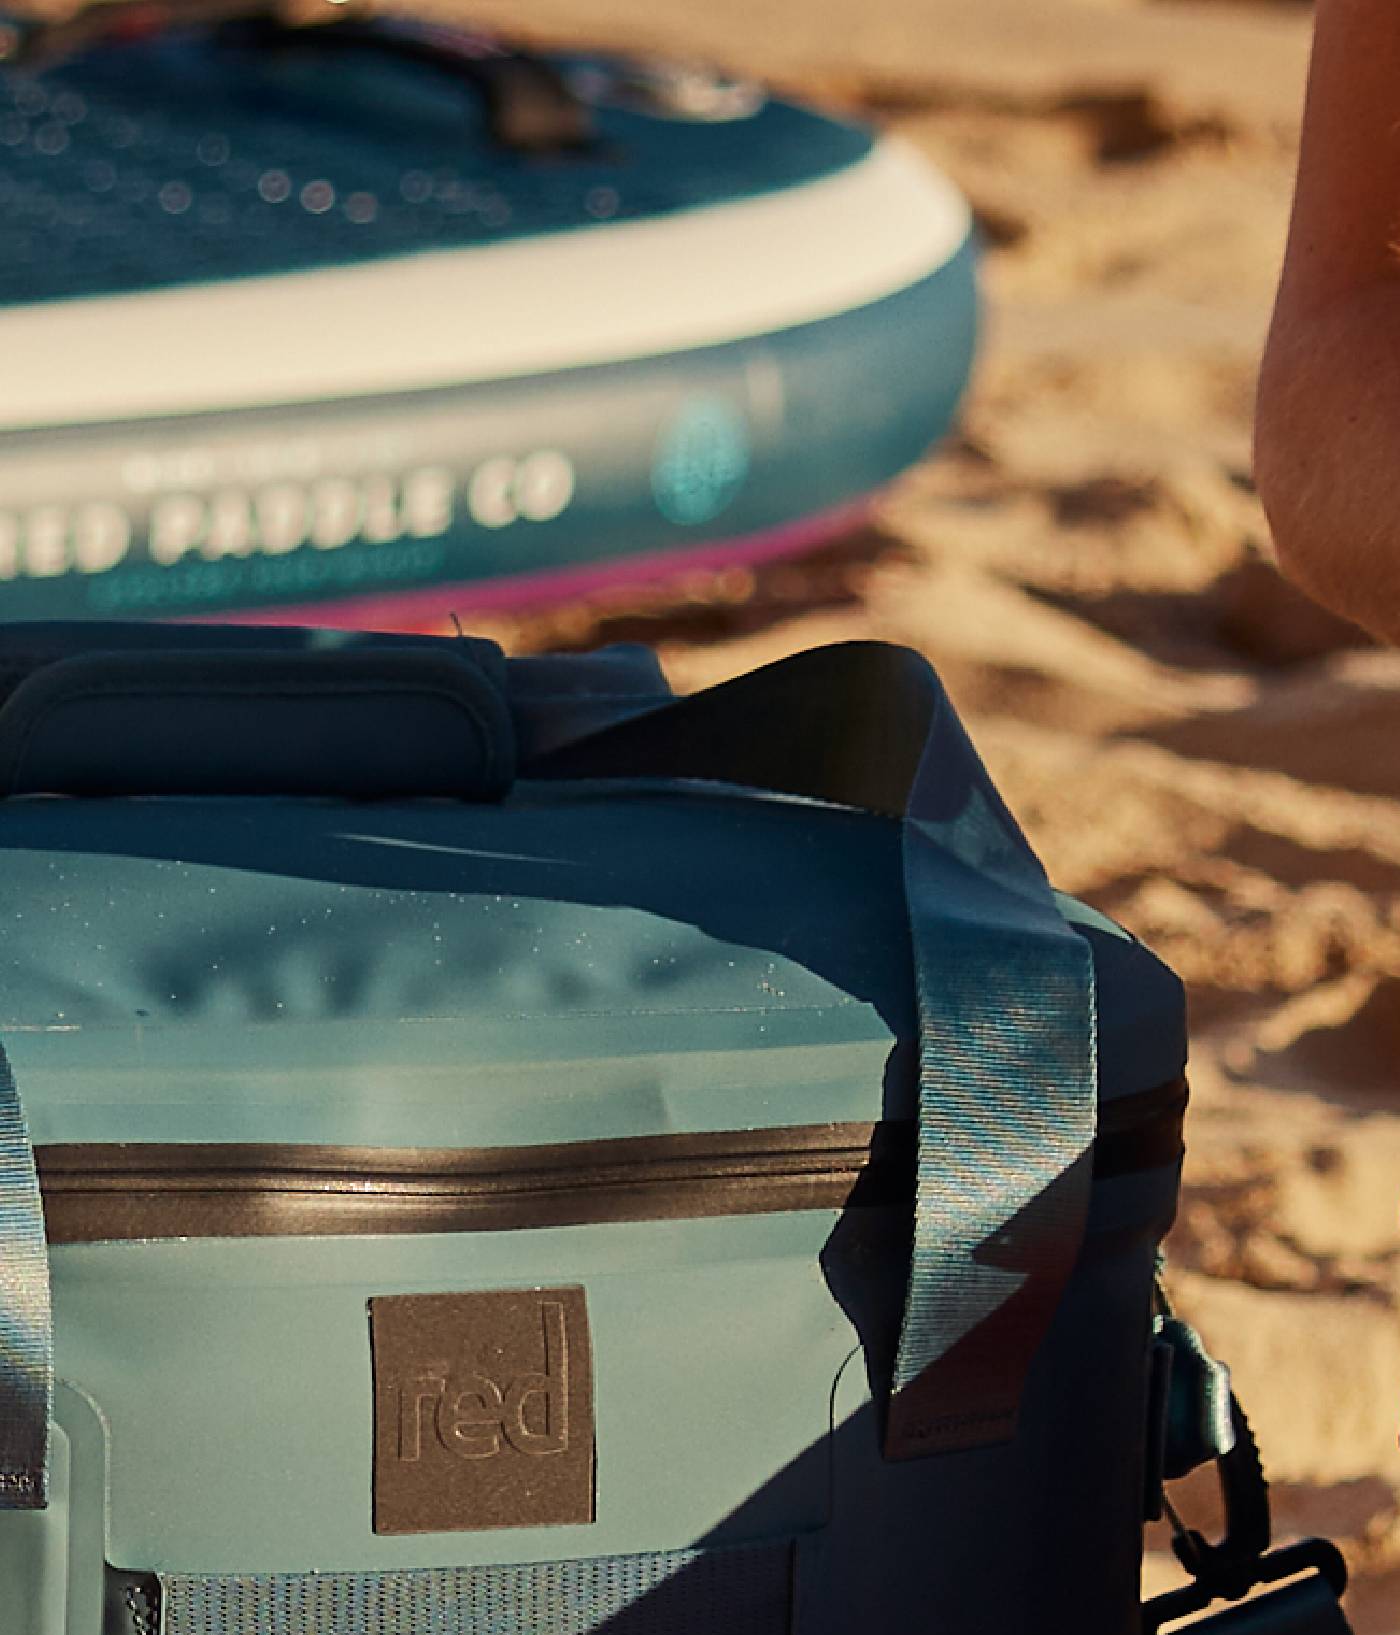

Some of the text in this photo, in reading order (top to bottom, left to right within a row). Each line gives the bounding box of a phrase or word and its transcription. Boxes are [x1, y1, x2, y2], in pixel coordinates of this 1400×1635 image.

[148, 466, 455, 566] PADDLE
[469, 448, 575, 528] CO
[398, 1301, 569, 1462] red
